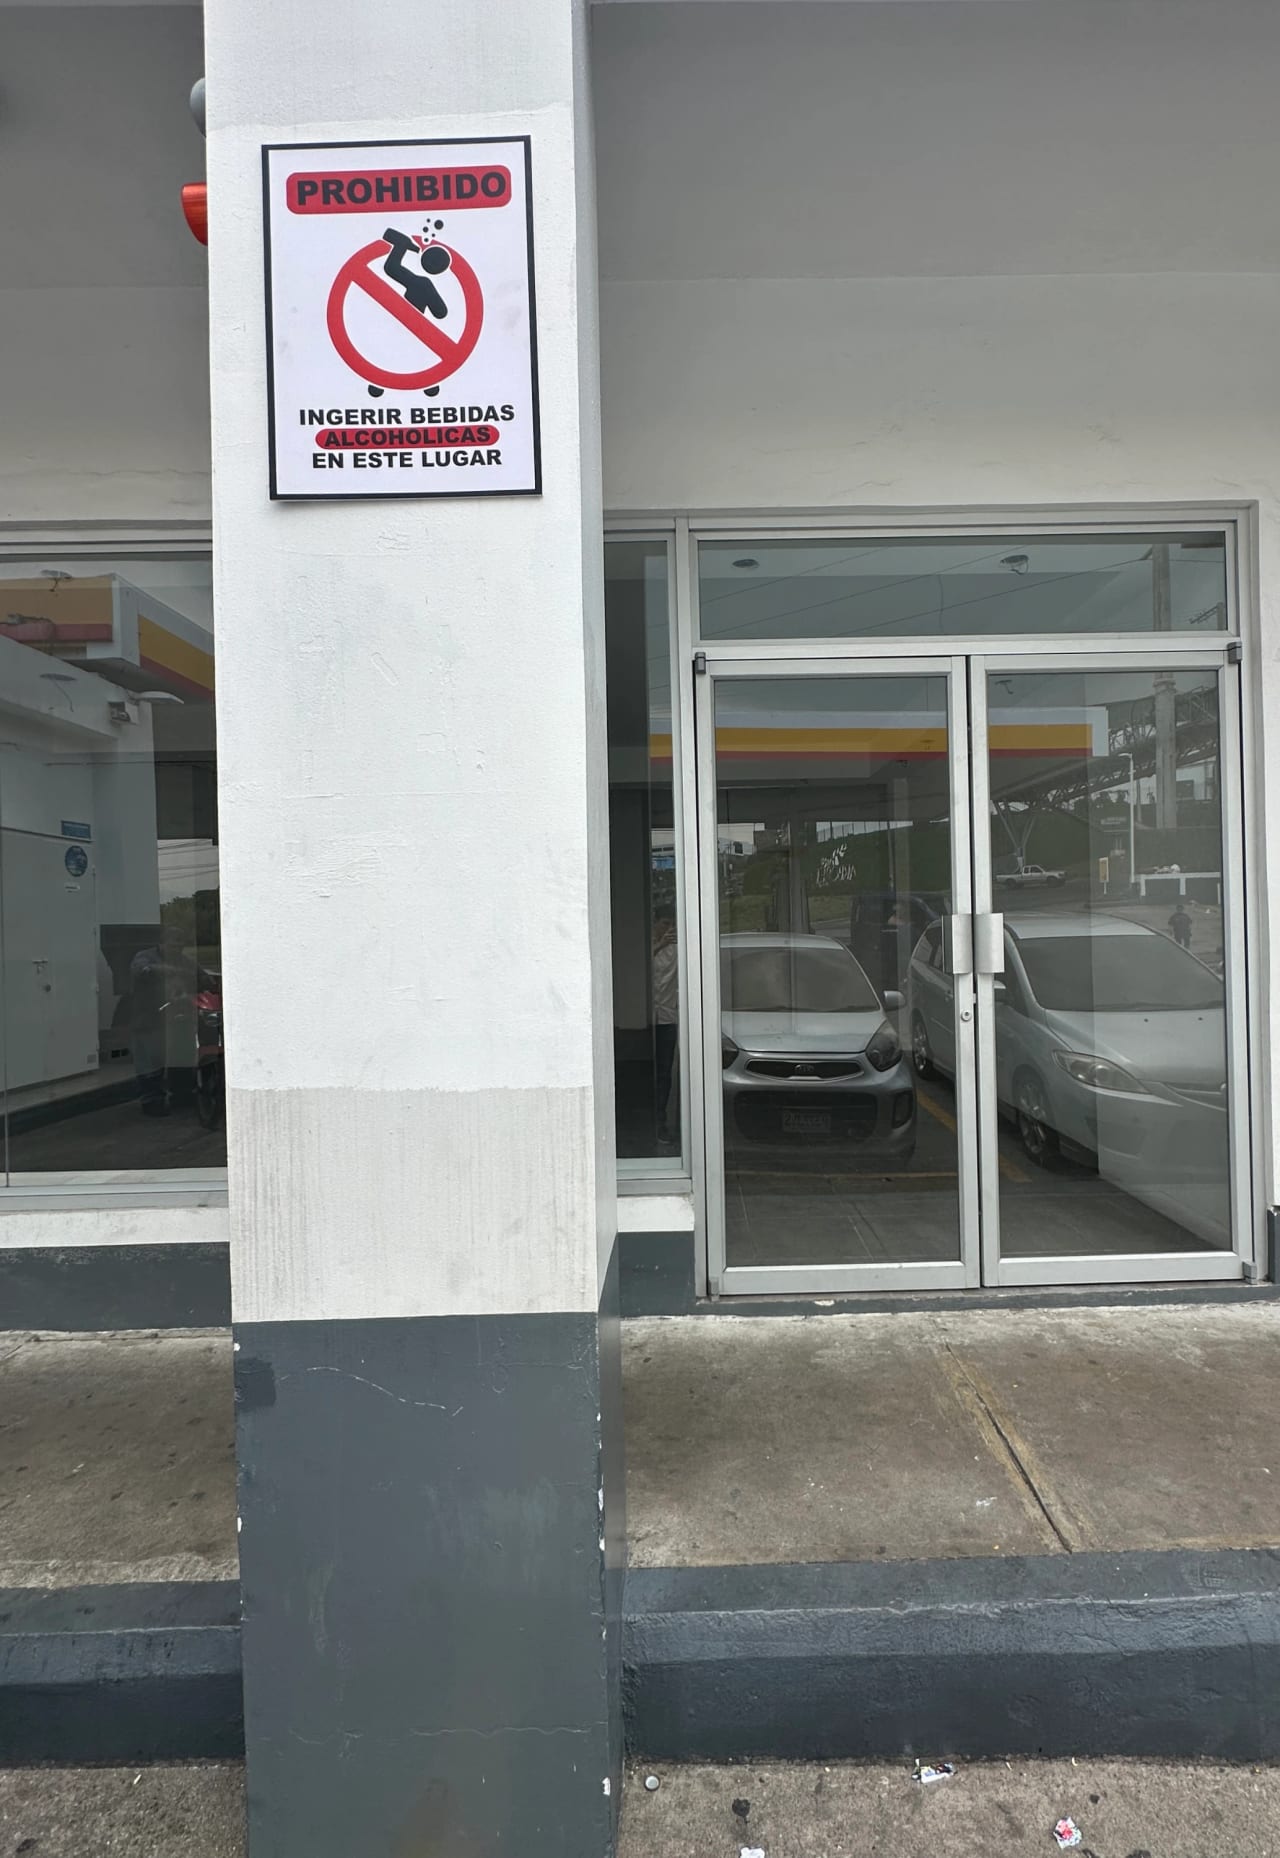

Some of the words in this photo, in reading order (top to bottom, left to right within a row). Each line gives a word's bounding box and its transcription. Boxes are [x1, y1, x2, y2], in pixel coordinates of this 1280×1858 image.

[296, 171, 507, 206] PROHIBIDO
[299, 408, 402, 426] INGERIR
[410, 404, 515, 424] BEBIDAS
[324, 427, 491, 447] ALCOHOLICAS
[312, 453, 344, 469] EN
[352, 451, 413, 469] ESTE
[421, 449, 503, 467] LUGAR
